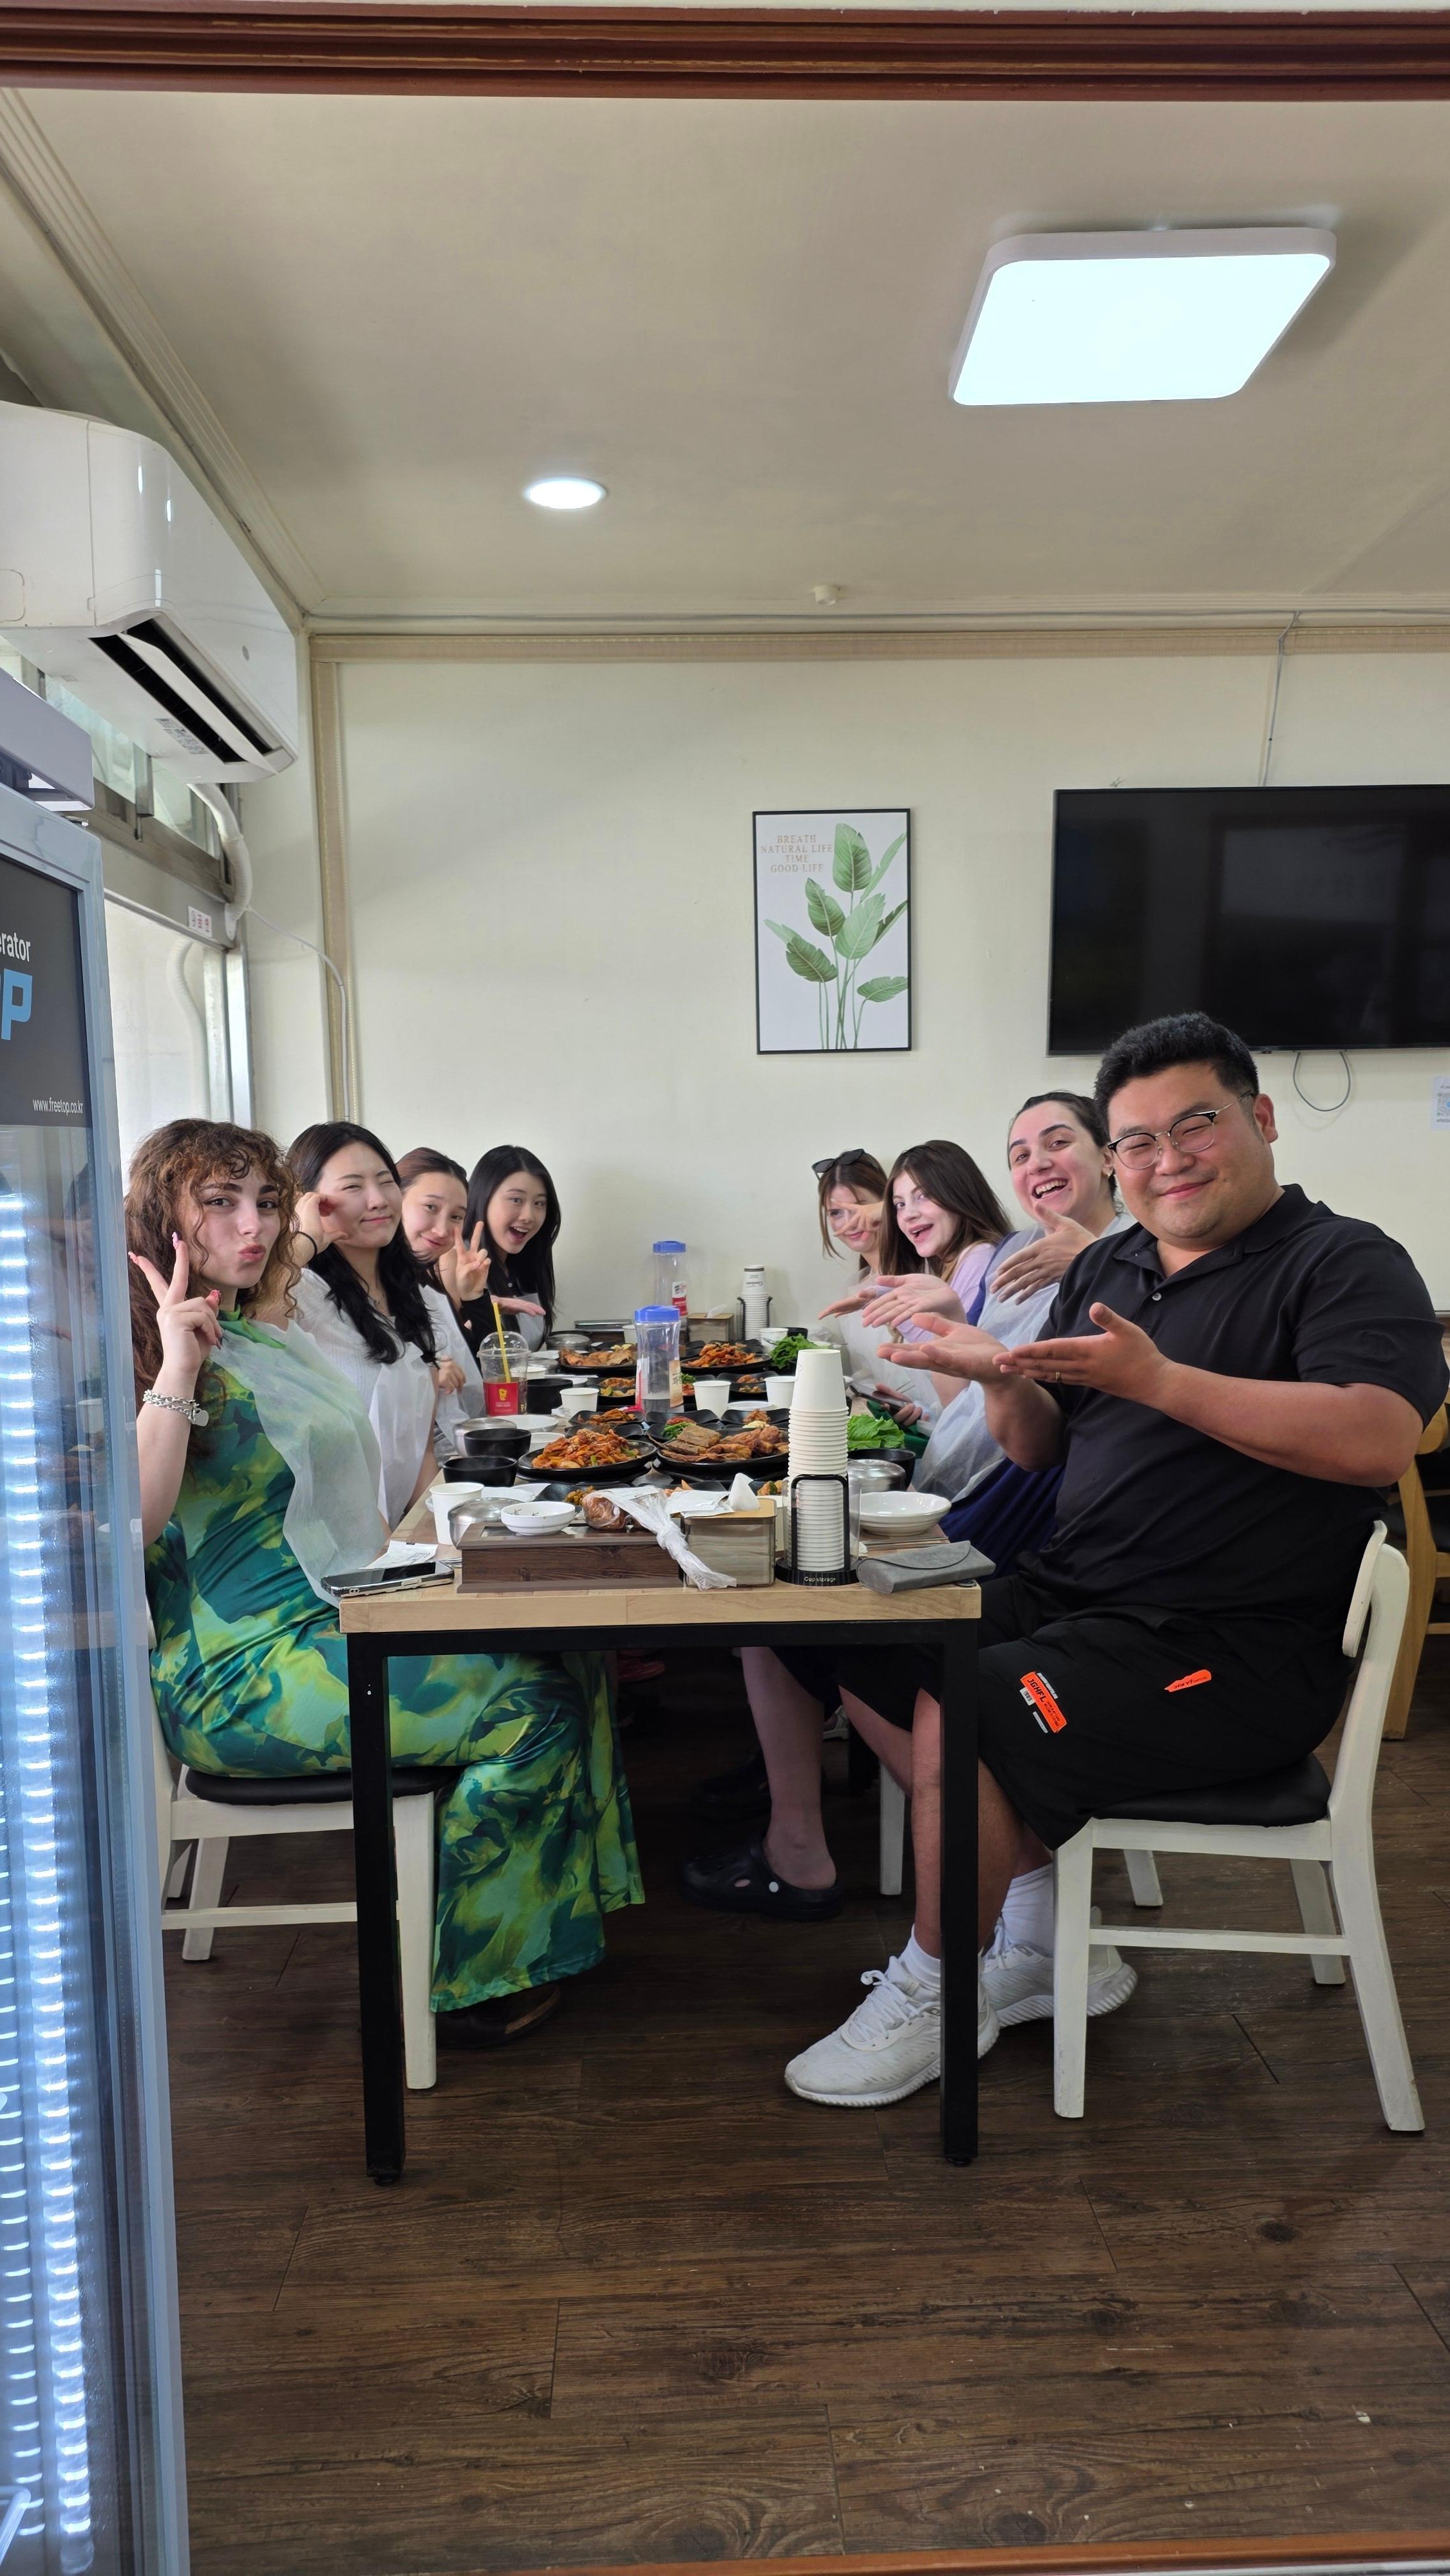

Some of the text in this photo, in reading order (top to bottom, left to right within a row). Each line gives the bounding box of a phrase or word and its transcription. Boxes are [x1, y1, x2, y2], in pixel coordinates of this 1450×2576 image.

[777, 835, 816, 844] BREATH
[760, 844, 833, 854] NATURAL LIFE
[786, 855, 810, 863] TIME
[770, 864, 824, 873] GOOD LIFE
[32, 1097, 84, 1117] www.freetop.co.kr
